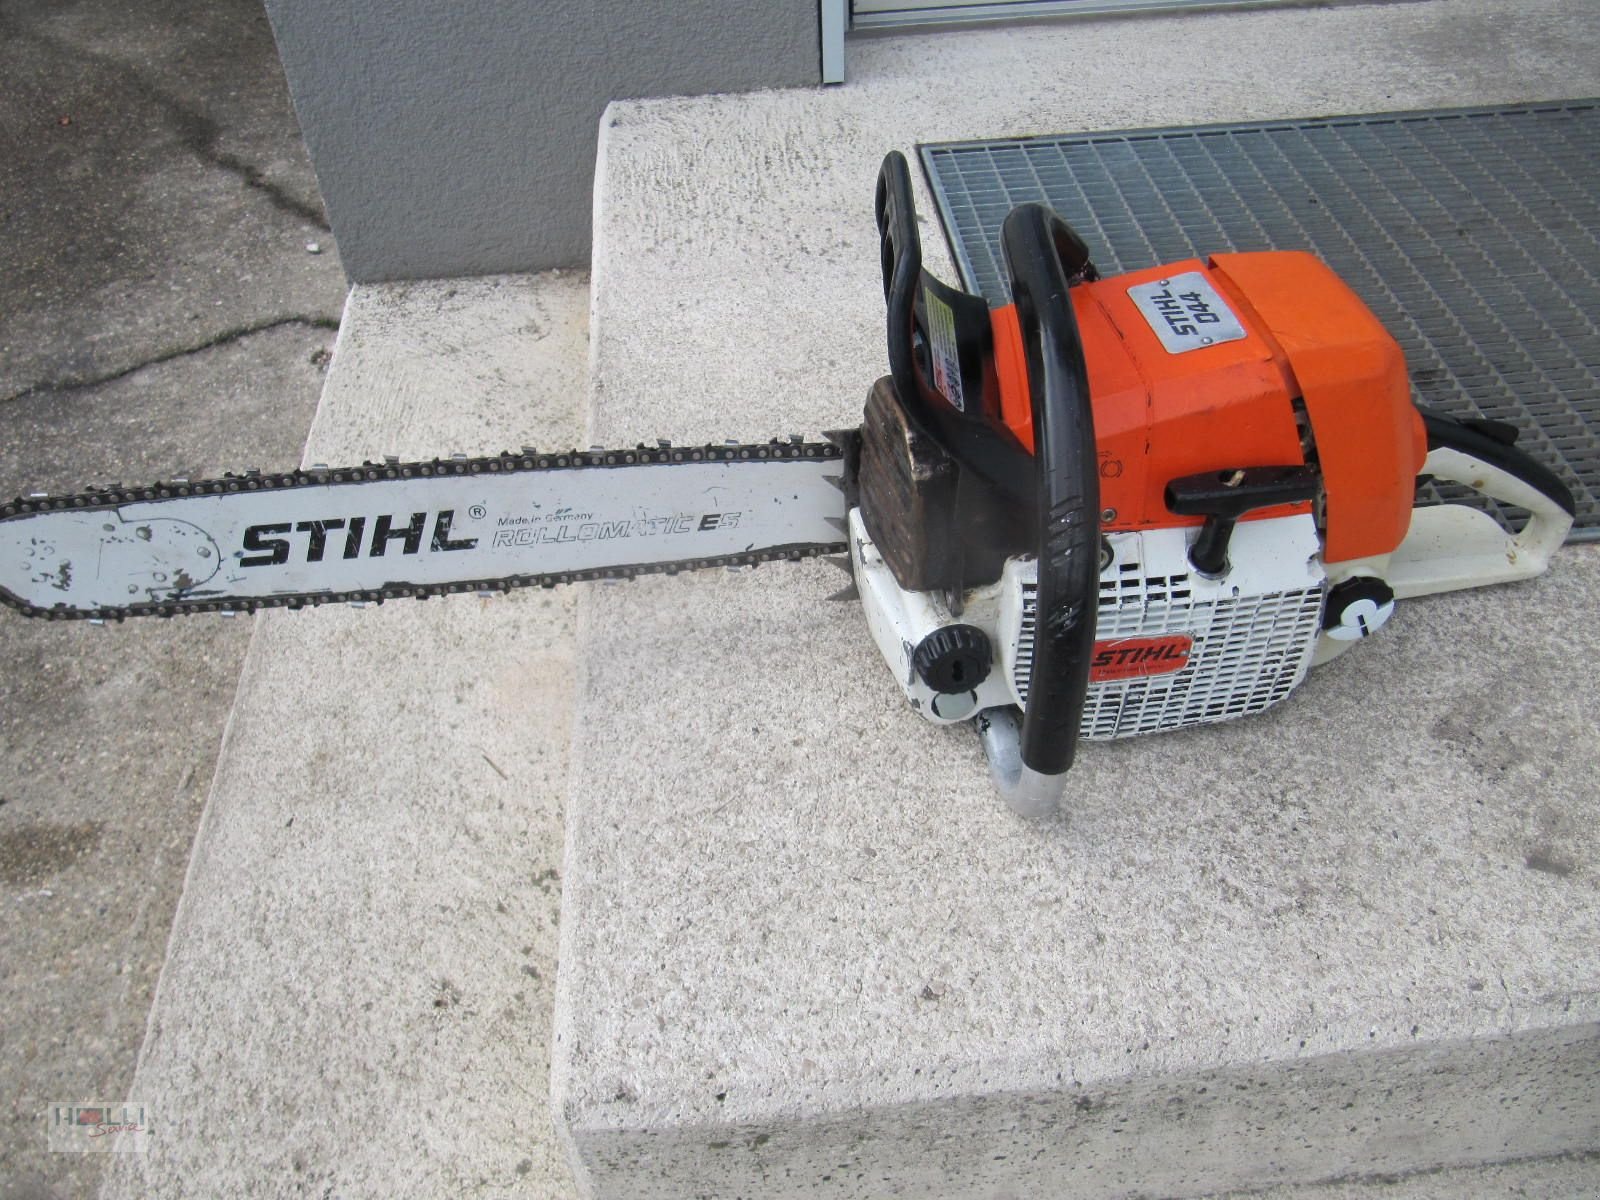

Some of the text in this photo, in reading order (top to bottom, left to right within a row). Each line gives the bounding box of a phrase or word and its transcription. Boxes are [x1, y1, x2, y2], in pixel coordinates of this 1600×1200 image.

[1150, 289, 1199, 336] STIHL
[1179, 291, 1221, 324] 044
[497, 512, 593, 526] Made in Germany
[697, 511, 742, 532] ES
[1091, 644, 1181, 667] STIHL
